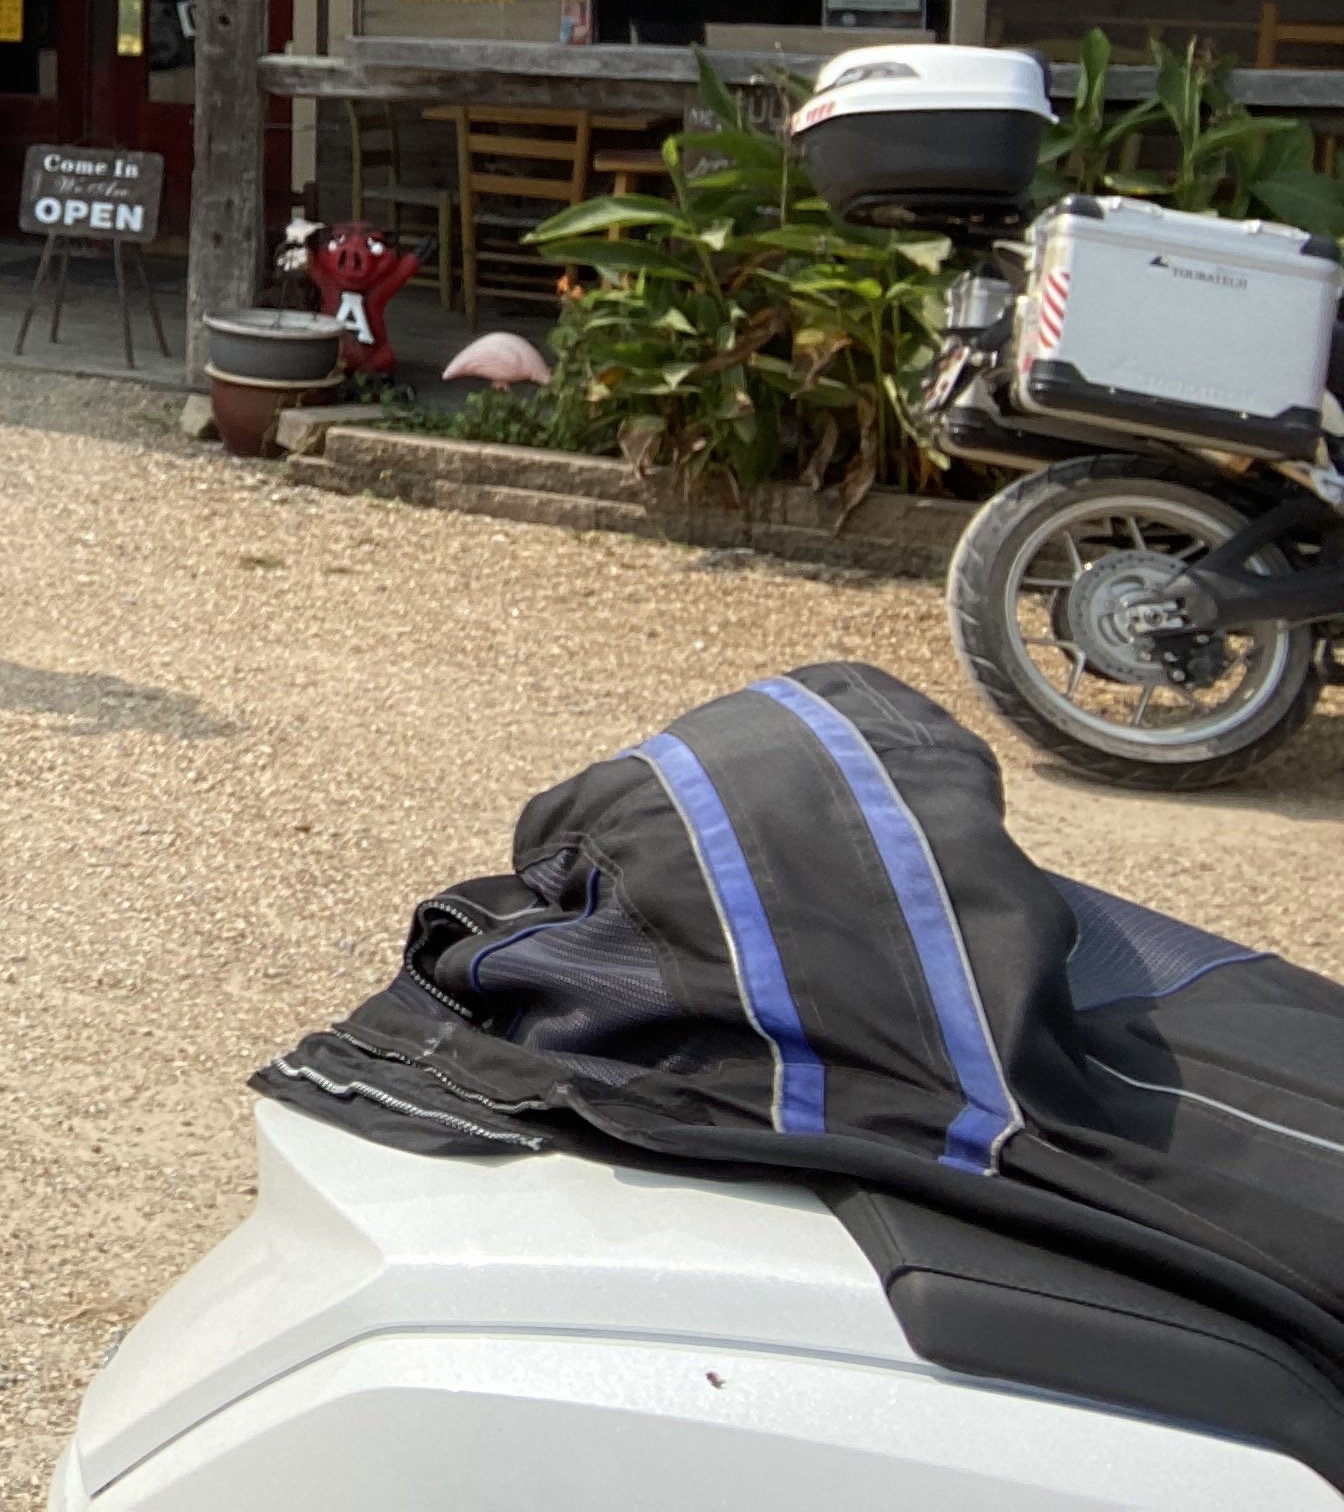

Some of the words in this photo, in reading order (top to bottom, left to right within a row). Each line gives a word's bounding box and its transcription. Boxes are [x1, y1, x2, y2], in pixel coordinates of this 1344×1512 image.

[43, 153, 108, 175] Come
[114, 158, 139, 179] In
[34, 196, 144, 232] OPEN
[336, 291, 375, 344] A
